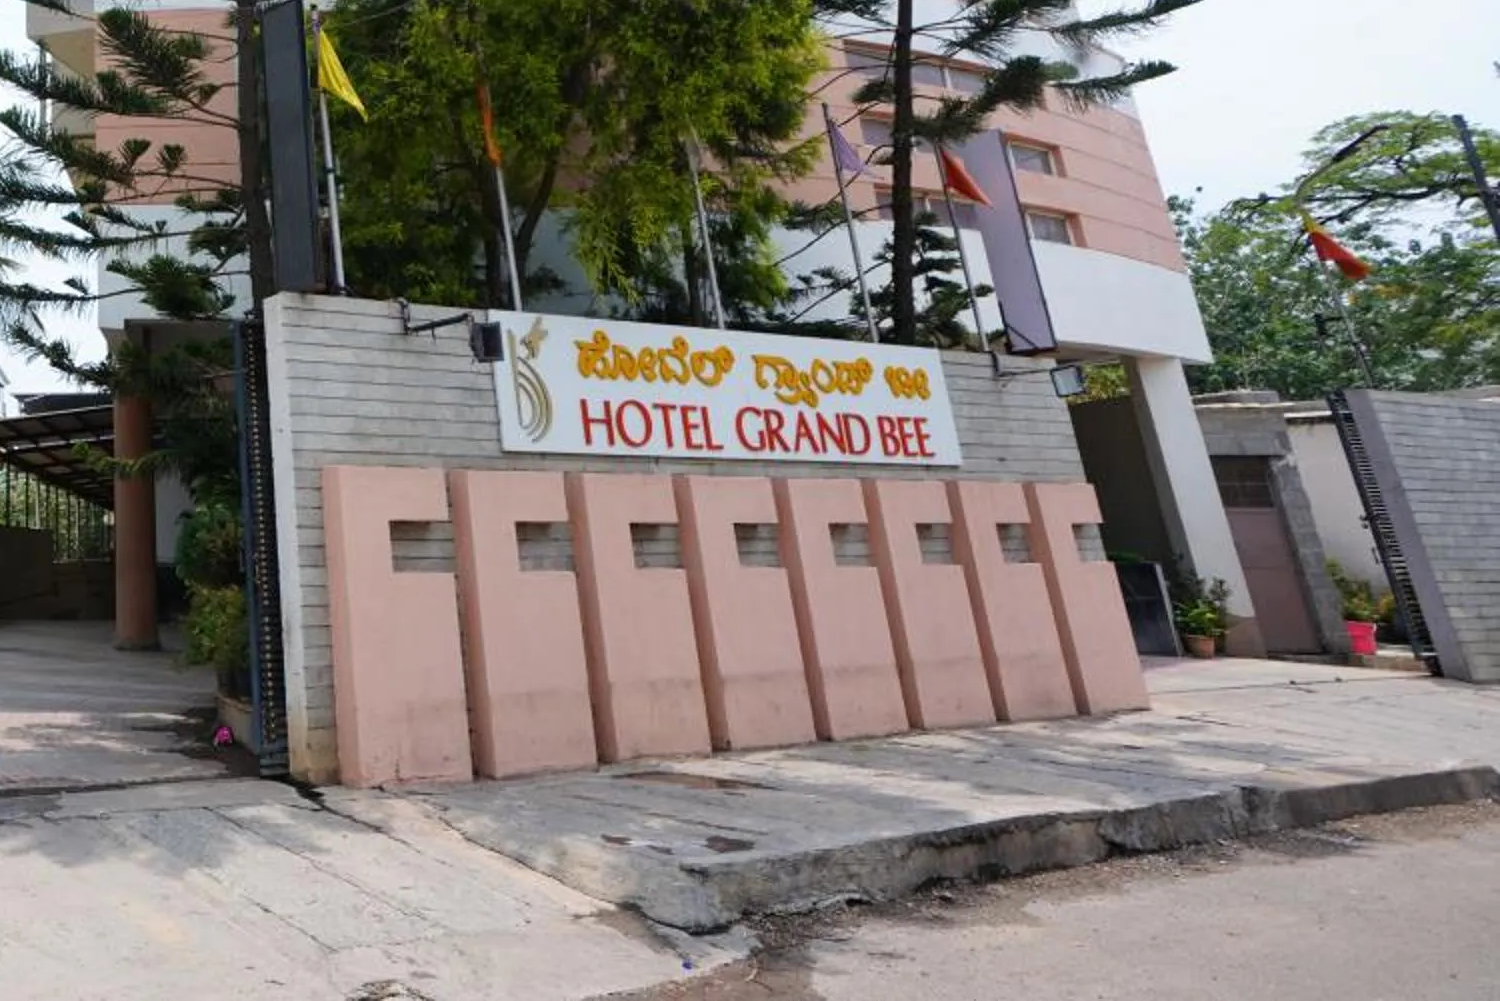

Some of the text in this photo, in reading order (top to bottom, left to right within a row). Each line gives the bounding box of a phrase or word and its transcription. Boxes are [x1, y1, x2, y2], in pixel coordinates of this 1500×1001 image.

[580, 398, 937, 458] HOTEL GRAND BEE
